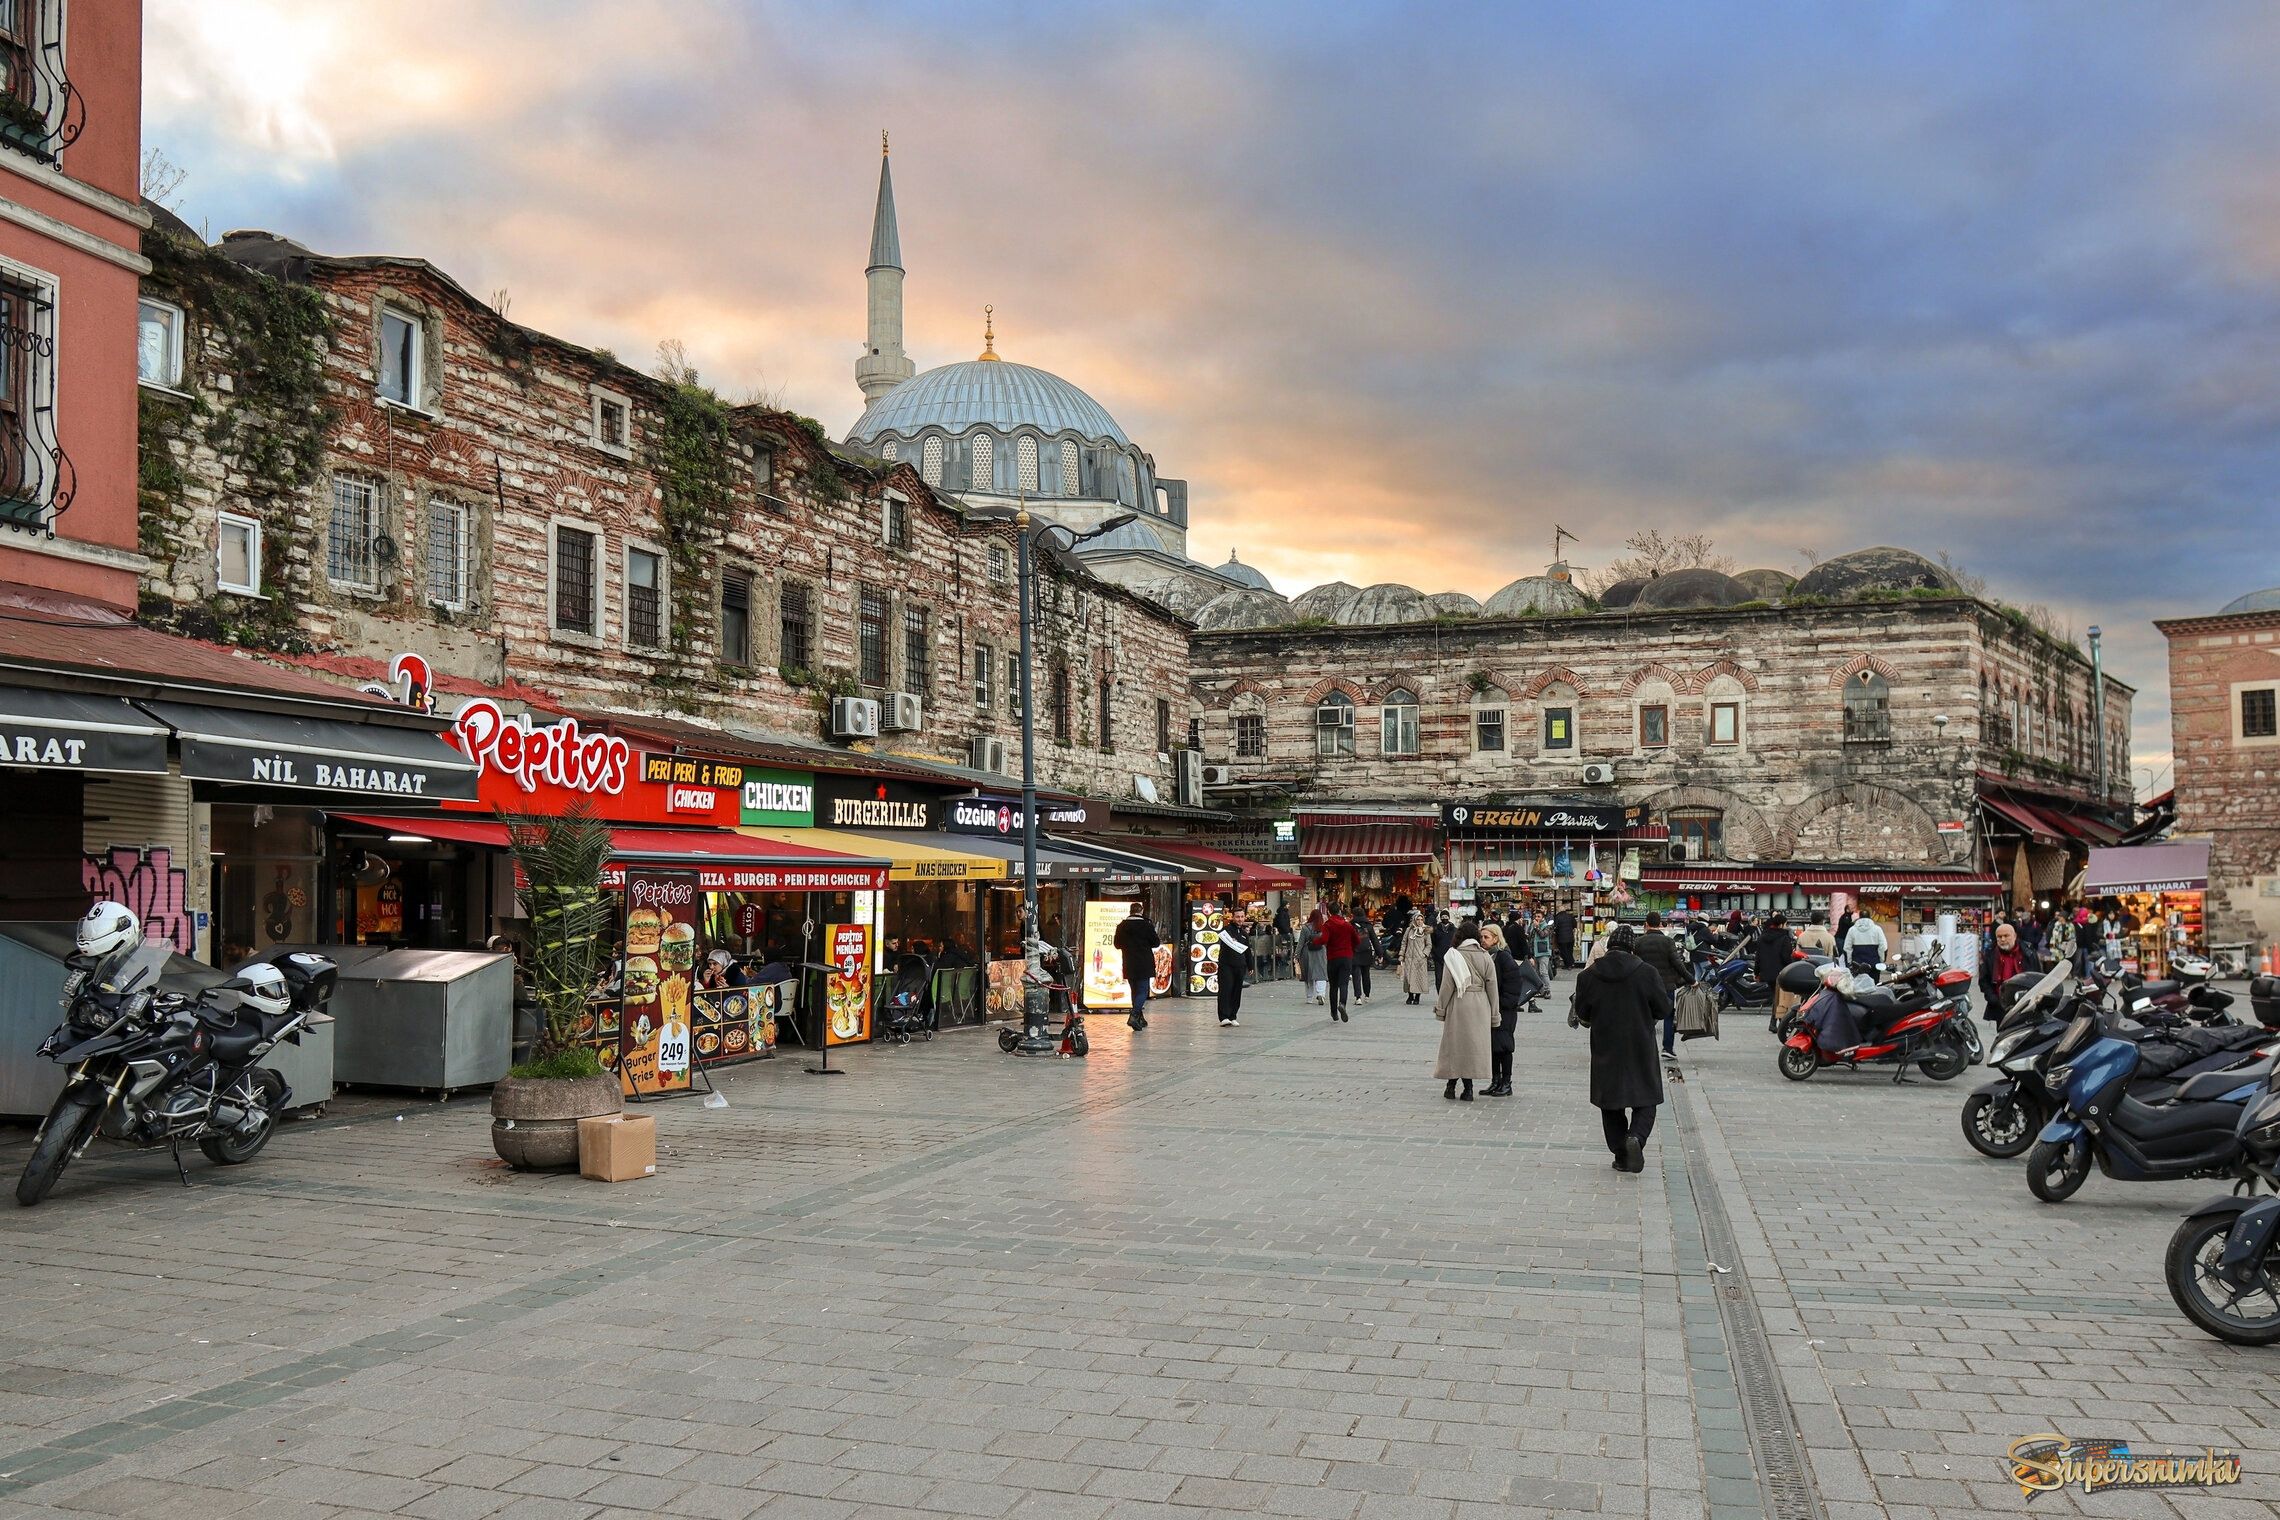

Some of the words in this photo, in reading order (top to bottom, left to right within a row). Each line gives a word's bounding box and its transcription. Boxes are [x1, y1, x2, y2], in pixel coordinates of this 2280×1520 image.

[450, 697, 629, 795] Pepitos
[252, 754, 298, 783] NİL
[315, 764, 427, 794] BAHARAT
[648, 757, 672, 781] PERİ
[673, 760, 696, 783] PERİ
[701, 764, 710, 783] &
[714, 765, 742, 787] FRIED
[674, 788, 715, 810] CHICKEN
[745, 781, 812, 812] CHICKEN
[834, 798, 927, 828] BURGERILLAS
[956, 802, 996, 827] ÖZGÜR
[1013, 810, 1040, 829] CHF
[1473, 808, 1541, 826] ERGÜN
[1545, 811, 1609, 830] Plastik
[1217, 839, 1269, 848] ŞEKERLEME
[915, 862, 936, 877] ANAS
[937, 862, 967, 877] CHICKEN
[1014, 862, 1052, 877] BUILLAS
[1488, 869, 1517, 877] ERGÜN
[603, 871, 625, 885] AST
[700, 872, 726, 886] IZZA
[734, 873, 777, 886] BURGER
[784, 874, 806, 886] PERI
[808, 874, 829, 886] PERI
[830, 874, 870, 886] CHICKEN
[632, 879, 692, 907] Pepitos
[1678, 883, 1718, 892] ERGÜN
[1859, 885, 1901, 894] ERGÜN
[2099, 884, 2140, 895] MEYDAN
[2145, 880, 2191, 892] BAHARAT
[837, 930, 863, 943] PEPİTOS
[1102, 934, 1114, 945] 29
[836, 942, 863, 955] MENÜLER
[661, 1043, 683, 1061] 249
[626, 1052, 656, 1069] Burger
